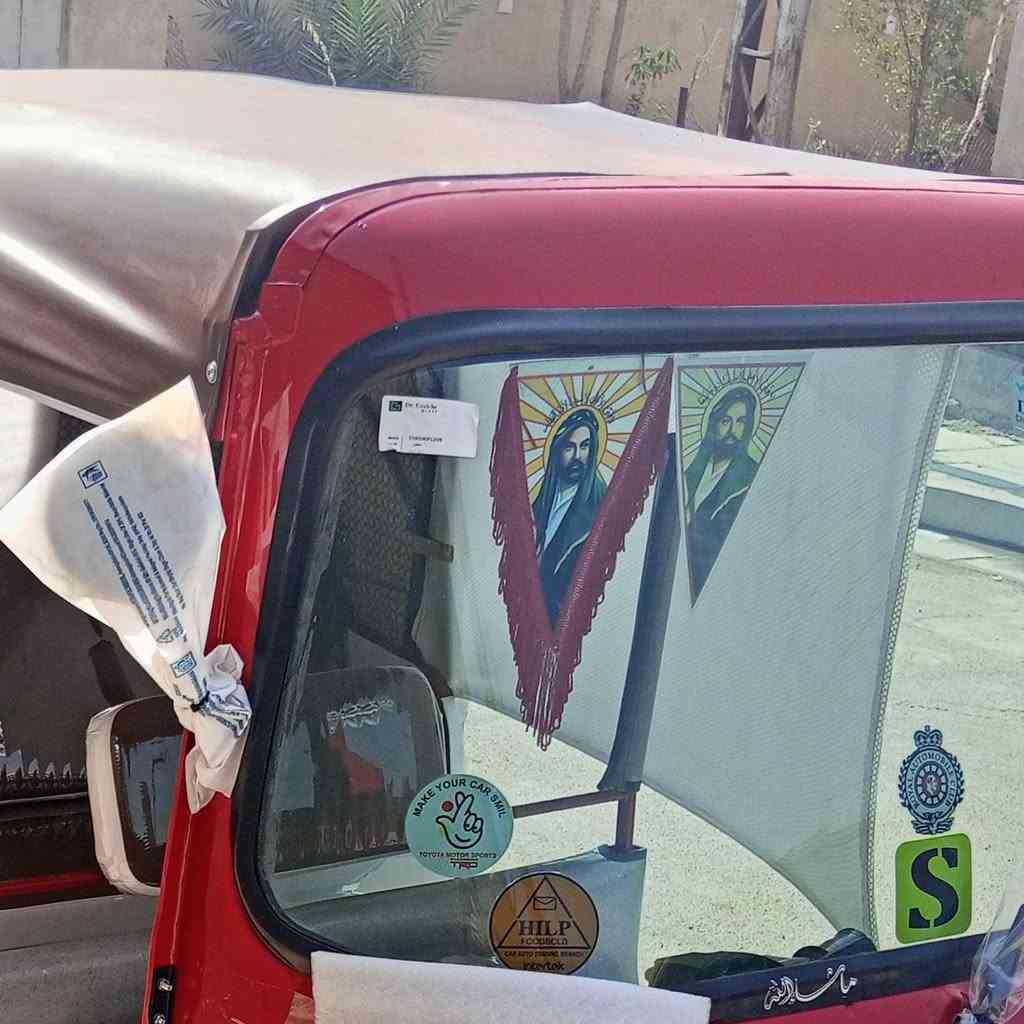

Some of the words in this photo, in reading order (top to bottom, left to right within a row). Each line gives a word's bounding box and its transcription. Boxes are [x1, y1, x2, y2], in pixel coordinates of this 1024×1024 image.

[412, 788, 436, 817] MAKE
[435, 778, 468, 792] YOUR
[469, 780, 492, 797] CAR
[908, 847, 960, 929] S
